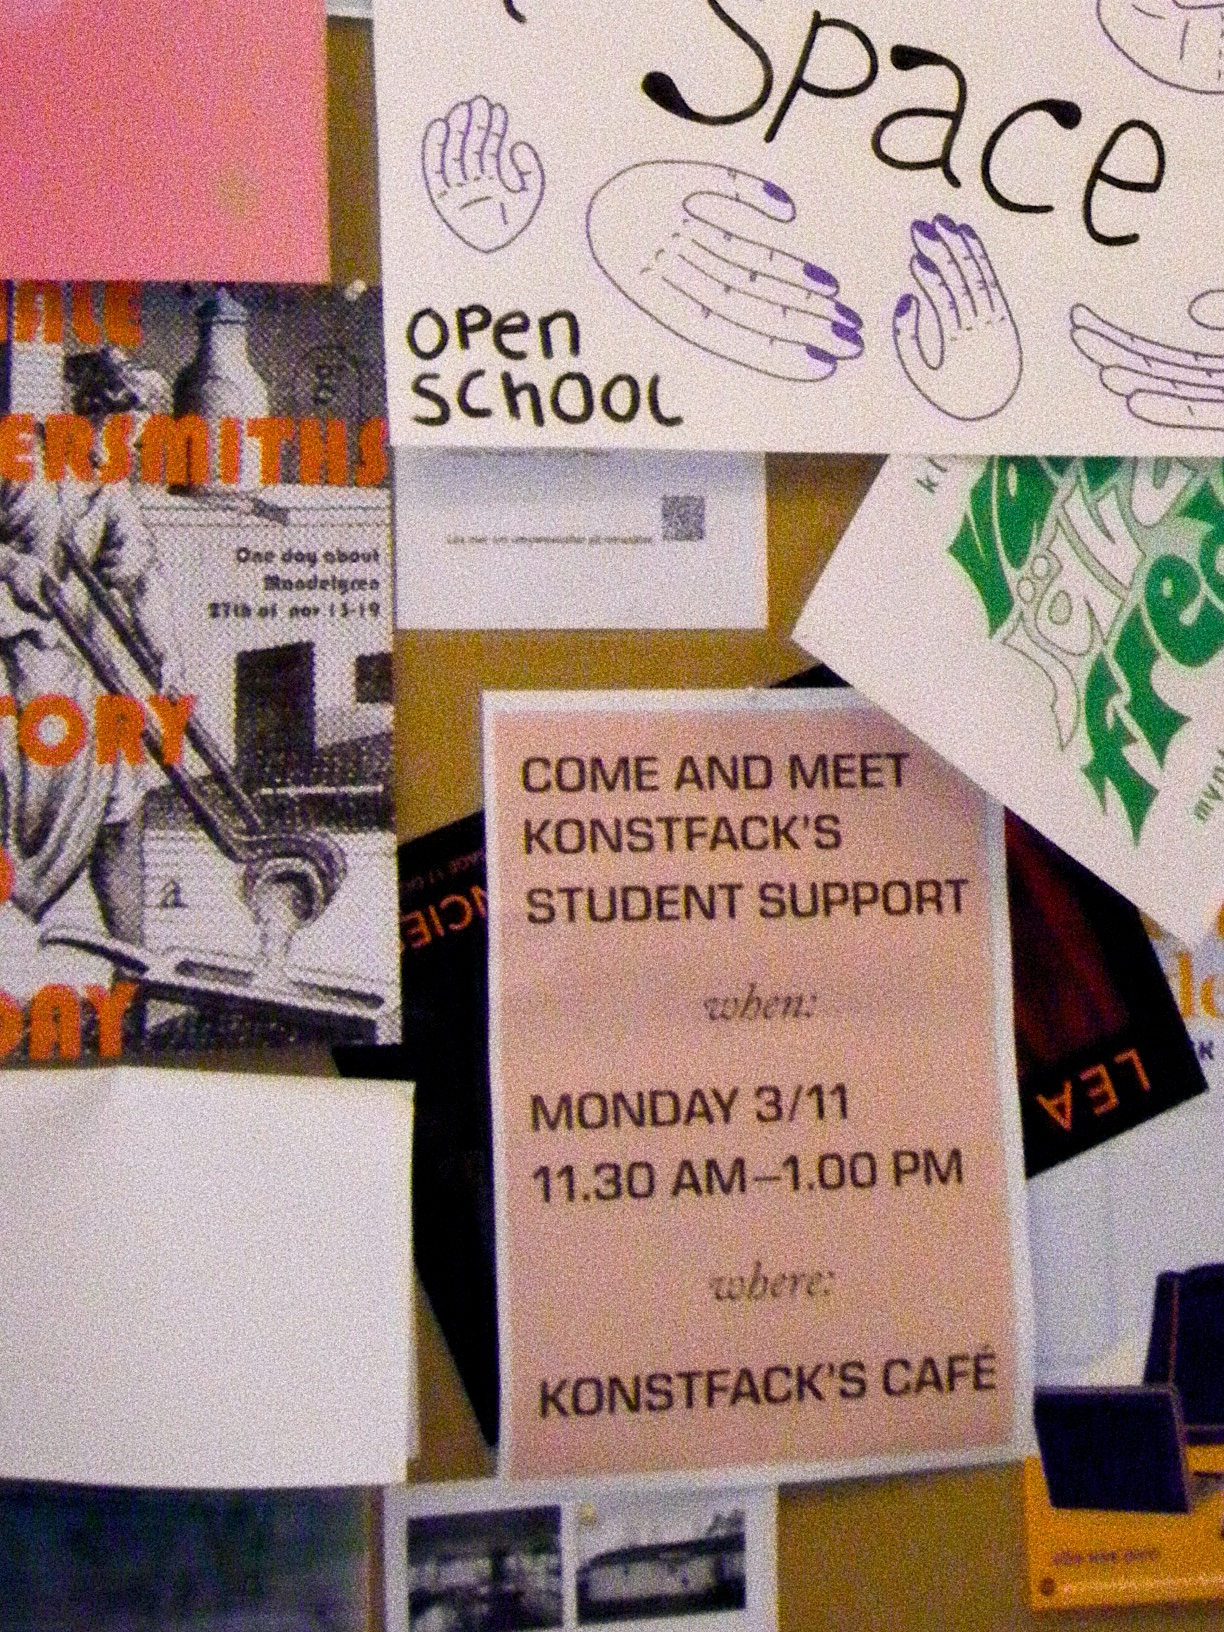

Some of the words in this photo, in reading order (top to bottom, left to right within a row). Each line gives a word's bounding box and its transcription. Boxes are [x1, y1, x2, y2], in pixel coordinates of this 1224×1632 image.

[0, 413, 389, 487] ERSMITHS
[236, 546, 276, 564] One
[280, 545, 319, 568] day
[323, 545, 380, 564] about
[520, 756, 659, 793] COME
[675, 754, 773, 790] AND
[789, 752, 910, 790] MEET
[522, 814, 843, 854] KONSTFACK'S
[525, 883, 745, 925] STUDENT
[758, 878, 969, 920] SUPPORT
[704, 983, 817, 1022] when:
[530, 1086, 740, 1132] MONDAY
[755, 1083, 850, 1125] 3/11
[1036, 1048, 1151, 1132] LEA
[532, 1162, 656, 1203] 11.30
[893, 1148, 963, 1187] PM
[708, 1261, 837, 1303] where:
[538, 1361, 867, 1419] KONSTFACK'S
[883, 1344, 996, 1396] CAFÉ
